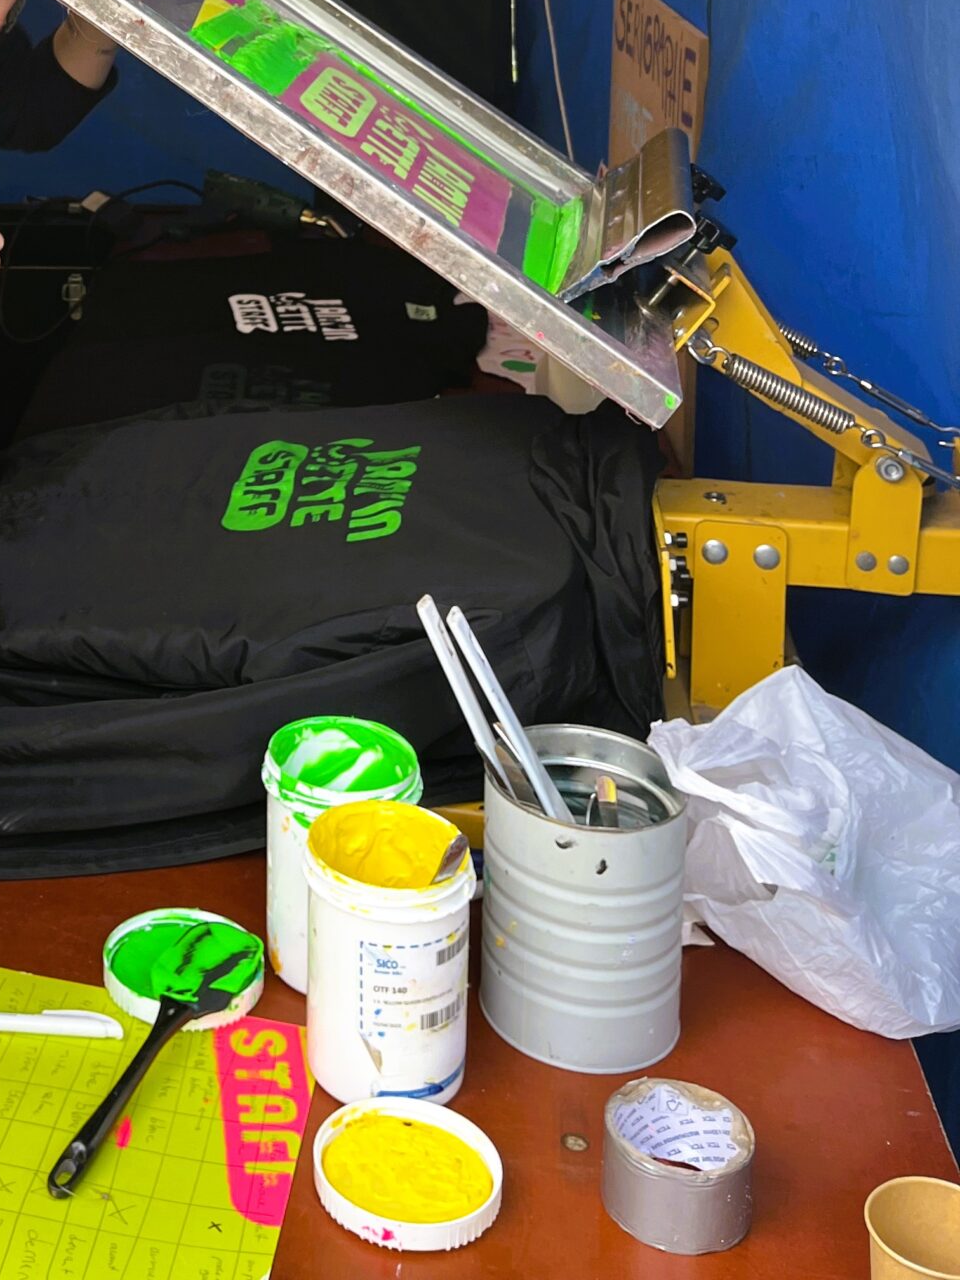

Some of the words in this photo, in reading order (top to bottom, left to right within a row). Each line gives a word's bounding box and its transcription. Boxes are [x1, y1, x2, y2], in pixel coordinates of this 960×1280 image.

[314, 76, 367, 128] STAFF
[237, 450, 296, 517] STAFF
[376, 959, 398, 969] SICO
